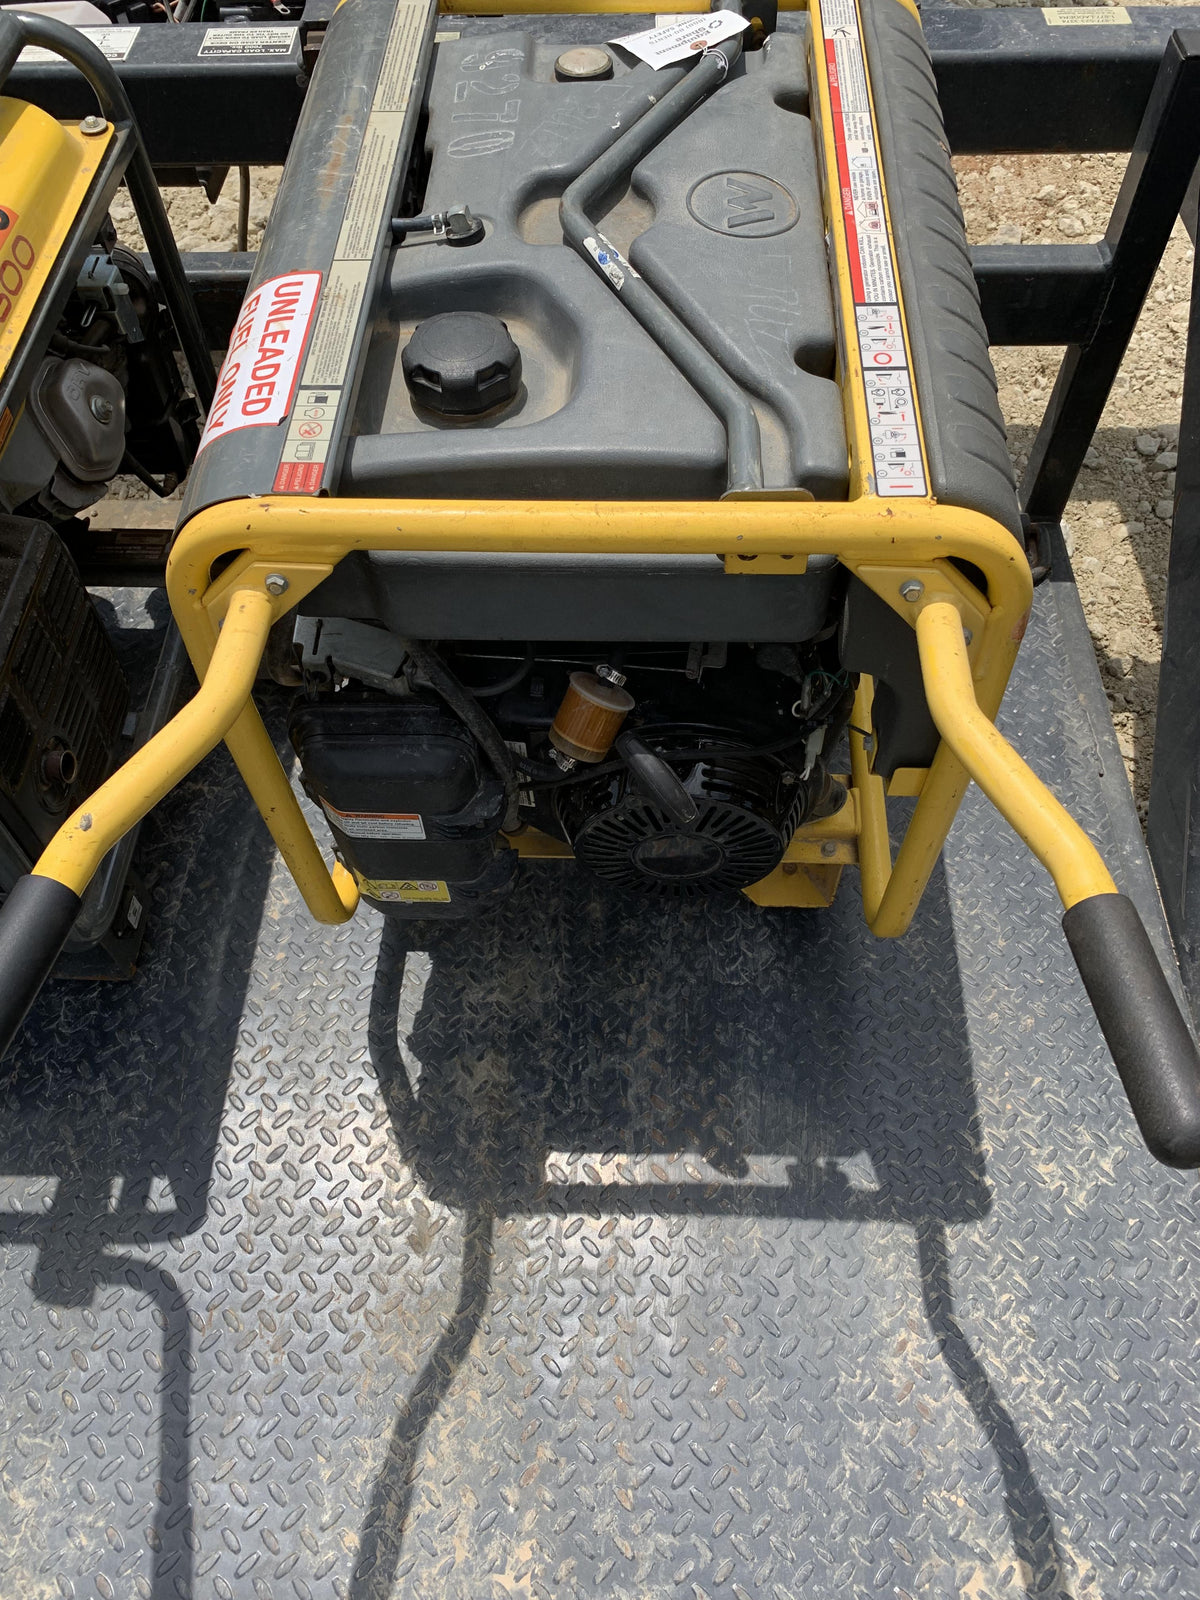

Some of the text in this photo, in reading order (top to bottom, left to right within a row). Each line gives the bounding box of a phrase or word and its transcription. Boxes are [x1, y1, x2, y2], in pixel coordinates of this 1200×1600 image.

[648, 27, 675, 40] SAFETY
[656, 30, 711, 56] Equipment
[675, 26, 706, 42] Share
[828, 63, 836, 82] PELIGRO
[842, 188, 851, 211] DANGER
[241, 281, 304, 416] UNLEADED
[207, 294, 261, 433] FUEL ONLY
[68, 363, 91, 401] OHV
[294, 464, 305, 485] PELIGRO
[309, 465, 319, 485] DANGER
